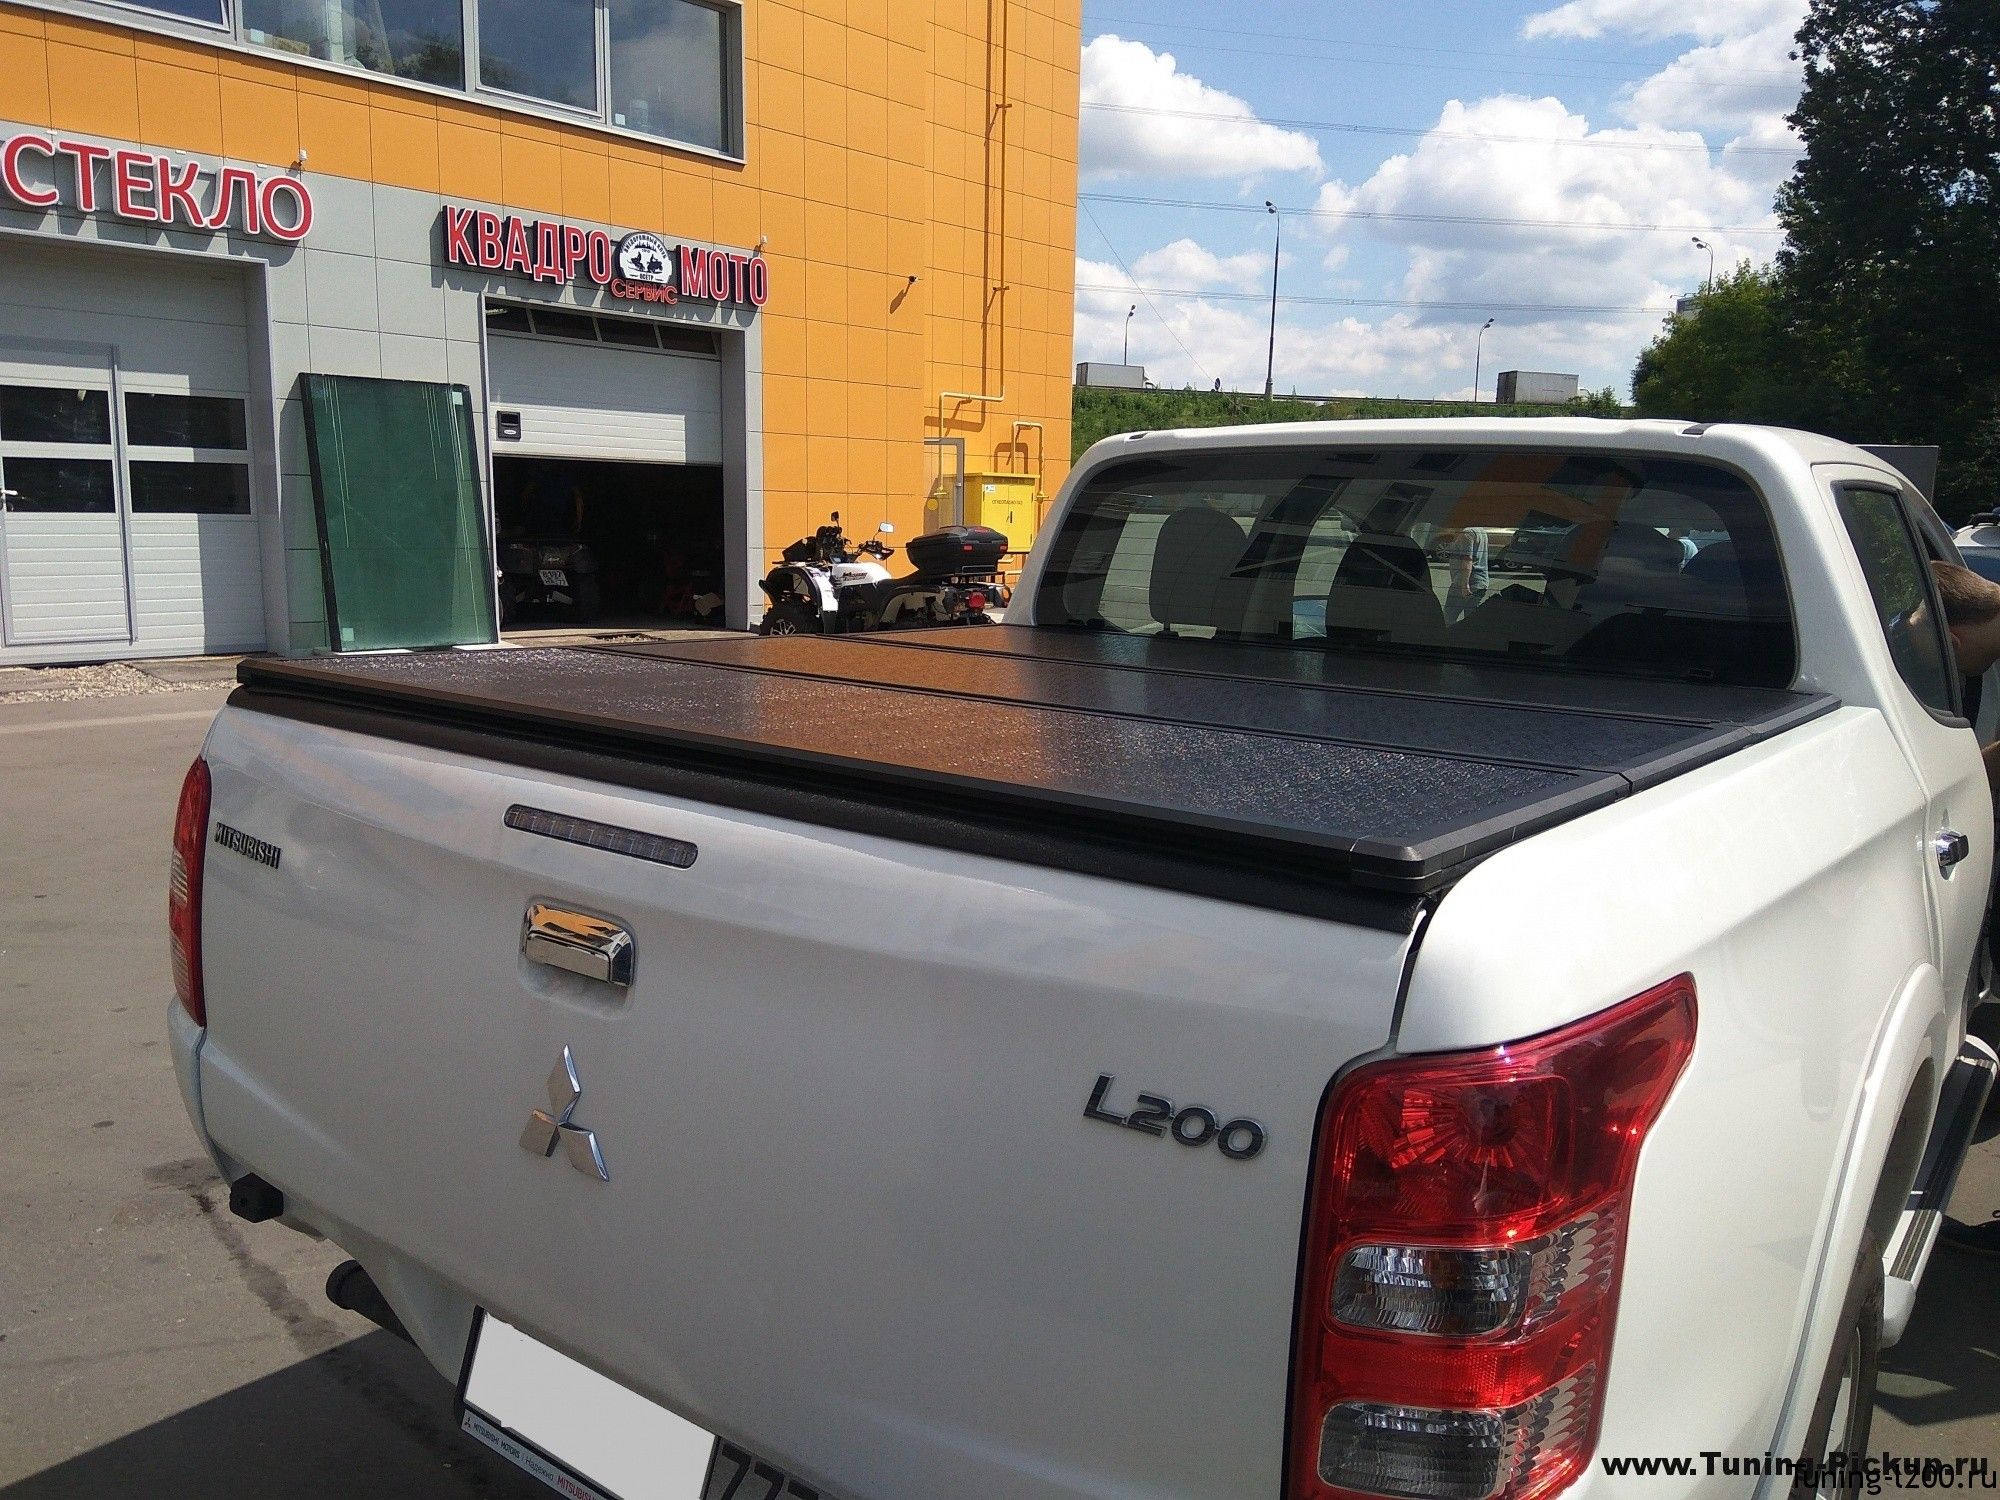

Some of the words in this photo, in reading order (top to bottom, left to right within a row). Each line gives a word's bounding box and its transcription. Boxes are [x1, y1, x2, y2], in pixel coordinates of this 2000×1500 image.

[2, 133, 314, 241] СТЕКЛО
[443, 204, 612, 285] КВАДРО
[678, 243, 769, 307] МОТО
[611, 278, 678, 305] СЕРВИС
[214, 821, 281, 870] MITSUBISHI
[1083, 1071, 1268, 1161] L200
